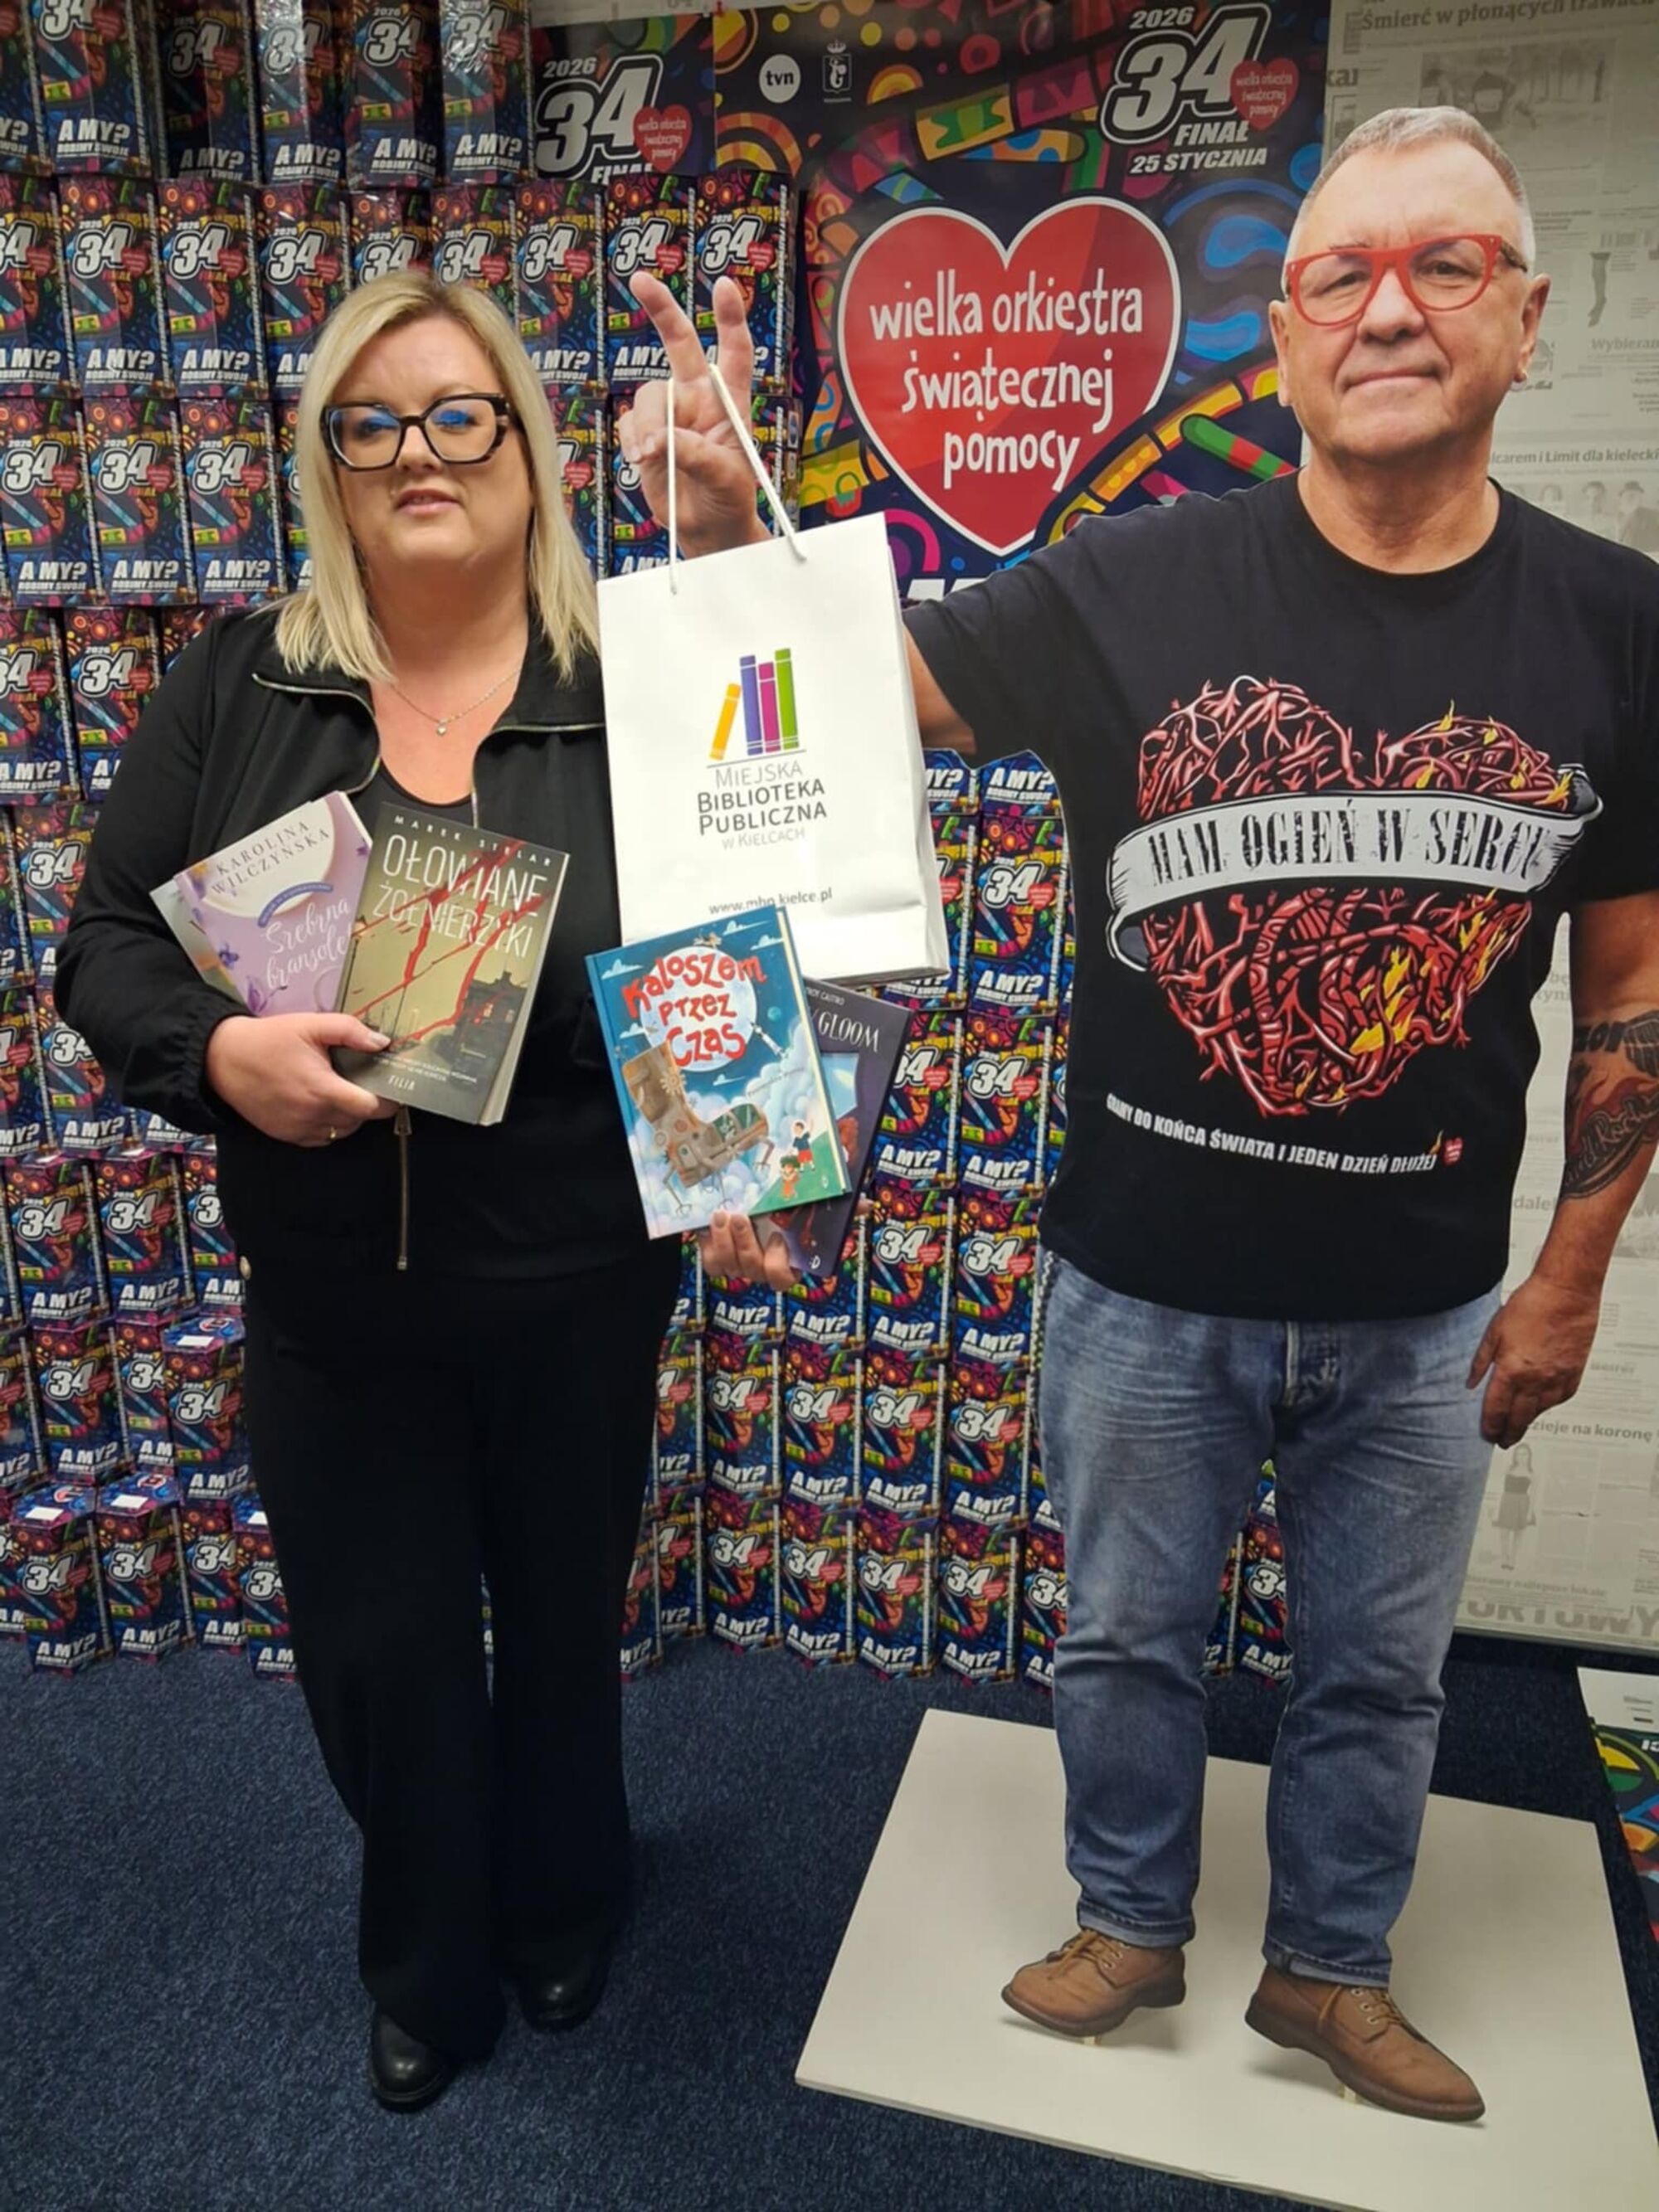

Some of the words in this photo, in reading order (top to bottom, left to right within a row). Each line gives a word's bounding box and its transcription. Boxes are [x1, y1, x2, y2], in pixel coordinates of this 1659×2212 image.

[41, 0, 90, 38] 34
[448, 6, 504, 57] 34
[1129, 7, 1194, 29] 2026
[1361, 11, 1432, 31] Śmierć
[1437, 12, 1452, 24] w
[265, 20, 320, 71] 34
[366, 17, 413, 64] 34
[542, 56, 597, 78] 2026
[766, 70, 794, 86] tvn
[1104, 7, 1268, 140] 34
[59, 119, 72, 141] A
[75, 119, 130, 143] MY?
[537, 57, 660, 177] 34
[1174, 120, 1249, 147] FINAŁ
[275, 144, 289, 164] A
[292, 144, 341, 167] MY?
[374, 139, 390, 159] A
[393, 139, 436, 163] MY?
[455, 134, 472, 156] A
[474, 133, 522, 156] MY?
[1130, 154, 1160, 173] 25
[1164, 148, 1267, 172] STYCZNIA
[74, 222, 134, 275] 34
[168, 224, 230, 277] 34
[266, 230, 324, 282] 34
[440, 231, 491, 282] 34
[524, 226, 576, 280] 34
[615, 220, 669, 274] 34
[704, 216, 759, 272] 34
[870, 269, 983, 338] wielka
[993, 269, 1143, 337] orkiestra
[87, 349, 100, 369] A
[105, 348, 155, 370] MY?
[182, 349, 197, 369] A
[202, 349, 250, 370] MY?
[546, 351, 590, 367] MY?
[902, 348, 1112, 433] świątecznej
[4, 444, 61, 492] 34
[100, 444, 155, 492] 34
[195, 445, 248, 493] 34
[943, 434, 1079, 492] pomocy
[1583, 449, 1603, 462] dla
[19, 562, 34, 580] A
[39, 562, 87, 581] MY?
[114, 561, 128, 578] A
[134, 560, 179, 578] MY?
[207, 561, 221, 578] A
[225, 560, 270, 579] MY?
[80, 649, 136, 696] 34
[990, 768, 1005, 787] A
[1006, 770, 1054, 788] MY?
[698, 778, 825, 813] BIBLIOTEKA
[394, 815, 460, 841] MAREK
[699, 801, 827, 836] PUBLICZNA
[216, 821, 310, 876] KAROLINA
[1148, 820, 1222, 887] MAM
[1238, 800, 1356, 868] OGIEŃ
[1378, 808, 1410, 863] W
[27, 844, 80, 887] 34
[985, 862, 1042, 907] 34
[980, 970, 995, 989] A
[999, 971, 1044, 993] MY?
[818, 1011, 879, 1053] GLOOM
[969, 1057, 1029, 1097] 34
[880, 1145, 896, 1164] A
[898, 1148, 941, 1168] MY?
[1134, 1107, 1152, 1130] DO
[1154, 1115, 1206, 1146] KOŃCA
[1209, 1129, 1275, 1160] ŚWIATA
[1277, 1144, 1286, 1161] I
[1287, 1145, 1339, 1170] JEDEN
[1340, 1154, 1389, 1174] DZIEŃ
[1389, 1153, 1437, 1174] DŁUŻEJ
[966, 1155, 983, 1174] A
[986, 1158, 1029, 1179] MY?
[19, 1198, 68, 1239] 34
[109, 1191, 157, 1232] 34
[876, 1227, 930, 1262] 34
[963, 1237, 1020, 1274] 34
[32, 1293, 45, 1309] A
[49, 1287, 92, 1310] MY?
[120, 1285, 134, 1300] A
[138, 1278, 179, 1301] MY?
[791, 1310, 806, 1328] A
[811, 1315, 849, 1335] MY?
[875, 1317, 889, 1335] A
[895, 1321, 935, 1340] MY?
[963, 1328, 978, 1346] A
[983, 1329, 1024, 1351] MY?
[46, 1360, 95, 1398] 34
[713, 1379, 757, 1408] 34
[177, 1383, 228, 1422] 34
[791, 1388, 839, 1421] 34
[870, 1393, 922, 1426] 34
[957, 1406, 1010, 1439] 34
[1572, 1424, 1591, 1435] na
[1594, 1424, 1653, 1443] koronę
[60, 1449, 72, 1464] A
[77, 1442, 117, 1465] MY?
[791, 1471, 805, 1488] A
[810, 1476, 848, 1495] MY?
[869, 1477, 884, 1495] A
[888, 1481, 927, 1503] MY?
[955, 1492, 970, 1510] A
[974, 1494, 1017, 1516] MY?
[109, 1541, 158, 1580] 34
[713, 1534, 759, 1564] 34
[787, 1545, 827, 1577] 34
[23, 1555, 76, 1593] 34
[945, 1564, 993, 1596] 34
[788, 1624, 800, 1641] A
[802, 1631, 839, 1651] MY?
[946, 1642, 959, 1660] A
[962, 1648, 1000, 1669] MY?
